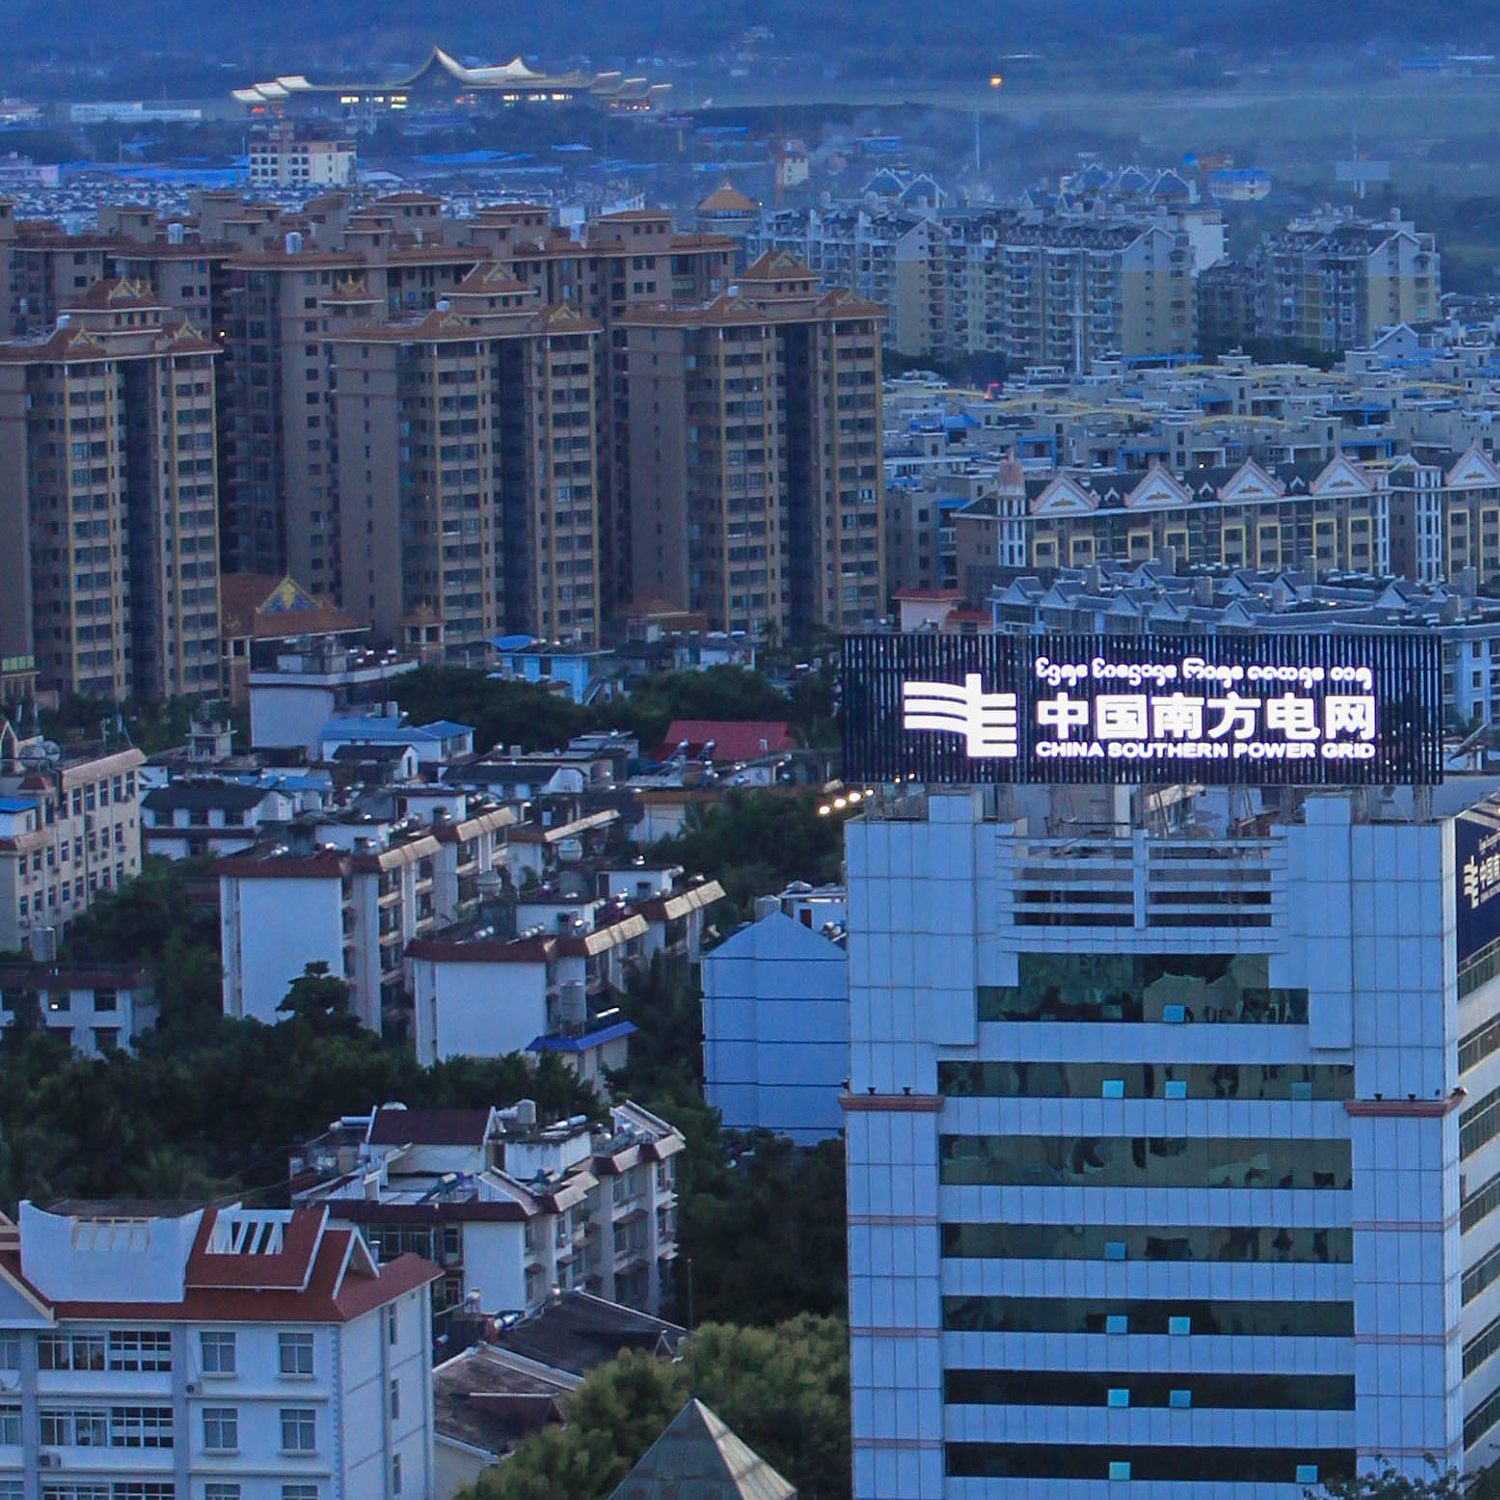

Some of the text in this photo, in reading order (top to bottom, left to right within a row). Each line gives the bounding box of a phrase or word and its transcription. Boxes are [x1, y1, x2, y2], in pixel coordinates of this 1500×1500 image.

[1037, 691, 1376, 740] 中国南方电网
[1036, 742, 1376, 759] CHINA SOUTHERN POWER GRID
